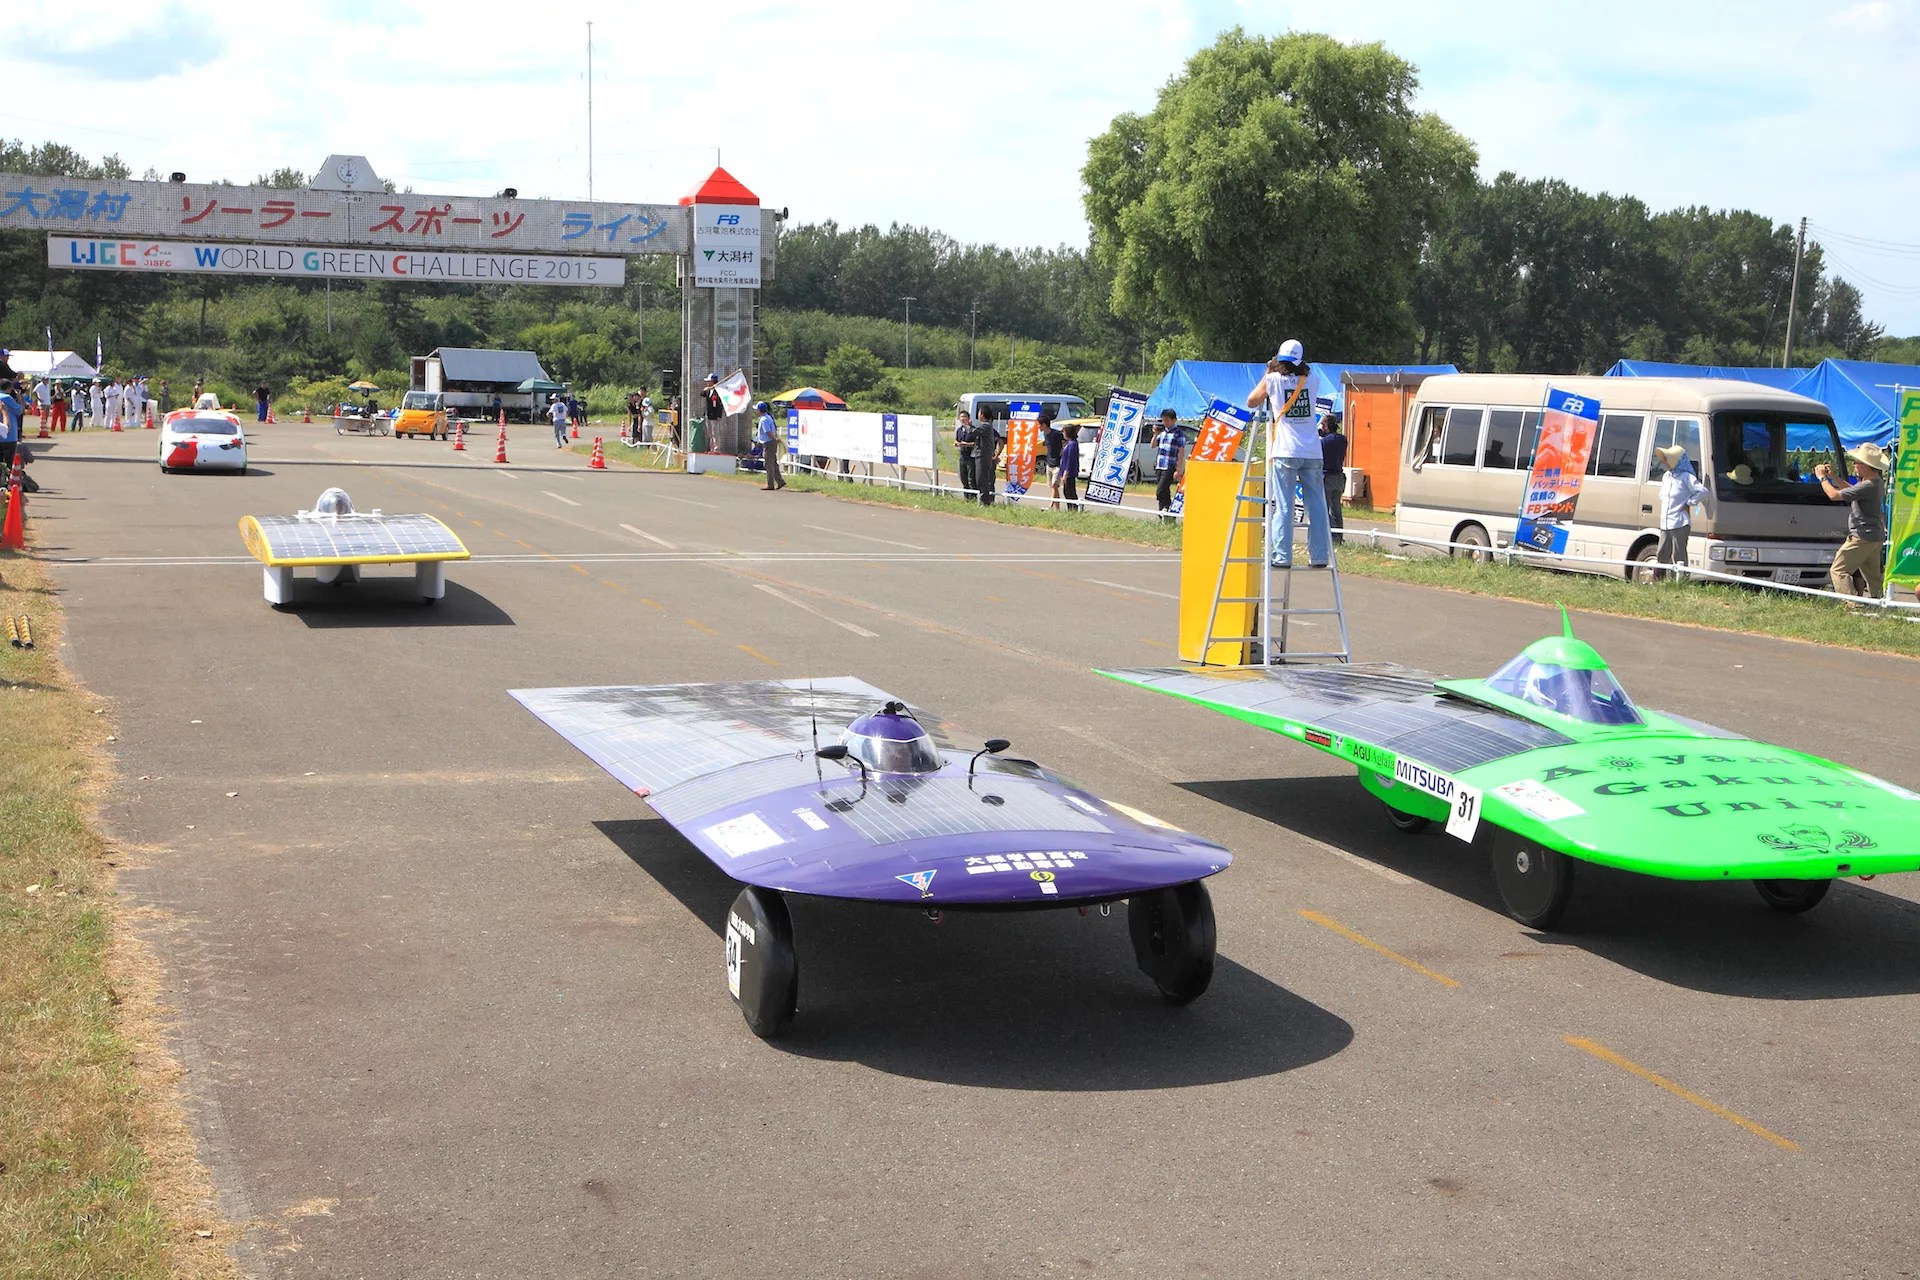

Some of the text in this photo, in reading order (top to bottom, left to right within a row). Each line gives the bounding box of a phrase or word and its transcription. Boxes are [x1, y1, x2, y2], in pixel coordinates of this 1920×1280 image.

[0, 186, 668, 244] 大潟村 ソーラー スポーツ ライン
[717, 215, 740, 225] FB
[697, 227, 759, 235] 古河電池株式会社
[195, 247, 598, 281] WORLD GREEN CHALLENGE 2015
[717, 250, 753, 262] 大潟村
[1286, 391, 1308, 400] RCE
[1287, 407, 1310, 417] 2015
[1562, 397, 1585, 414] FB
[1106, 405, 1138, 482] プリウス
[1195, 420, 1221, 460] ストッ
[1021, 421, 1036, 485] アイドリング
[1087, 484, 1122, 503] 取扱店
[1530, 491, 1556, 502] 信頼の
[1533, 533, 1549, 544] FB
[1353, 743, 1371, 761] AGU
[1593, 774, 1876, 796] Gakuin
[1458, 791, 1475, 822] 31
[1652, 797, 1867, 817] Univ.
